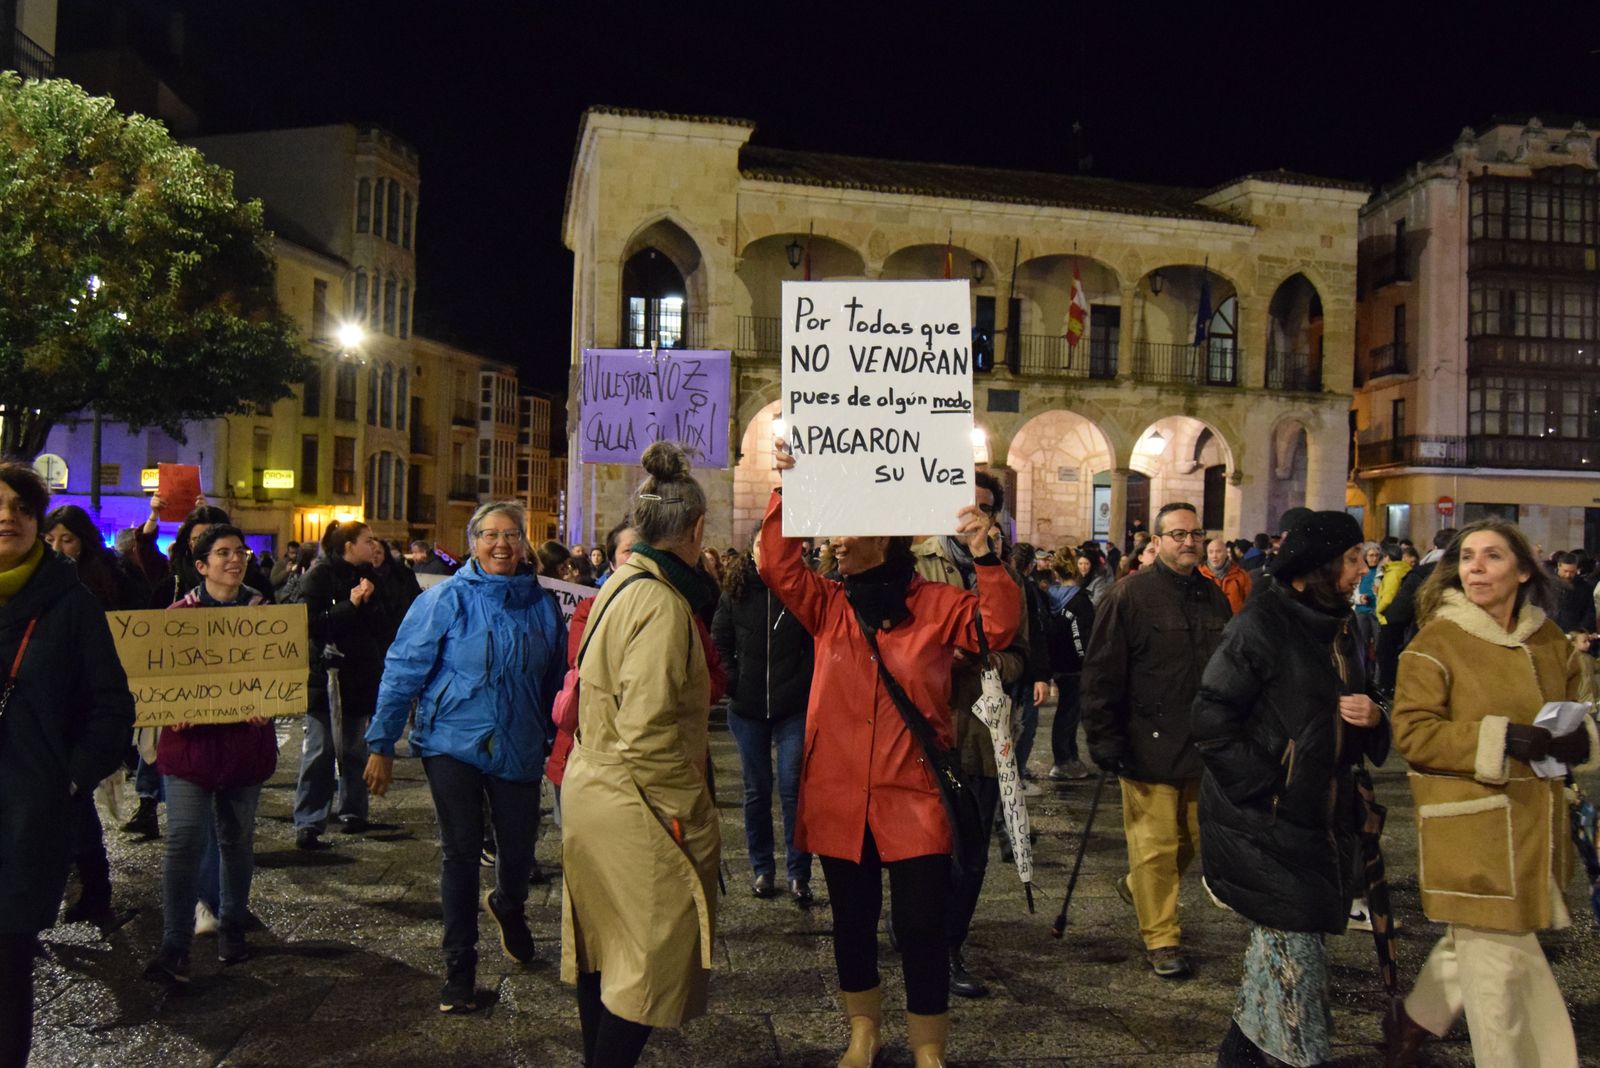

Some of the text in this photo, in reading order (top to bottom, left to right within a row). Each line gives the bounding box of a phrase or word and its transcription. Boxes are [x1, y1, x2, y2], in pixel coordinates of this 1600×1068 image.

[794, 296, 831, 333] Por
[920, 322, 961, 350] que
[790, 344, 830, 374] NO
[655, 356, 709, 402] VOZ
[790, 389, 841, 414] pues
[847, 386, 872, 406] de
[932, 391, 972, 410] modo
[586, 412, 637, 451] CALLA
[788, 425, 920, 455] APAGARON
[115, 615, 288, 640] YO OS INVOCO
[228, 647, 257, 664] DE
[262, 641, 300, 660] EVA
[229, 677, 262, 696] UNA
[264, 679, 304, 702] LUZ
